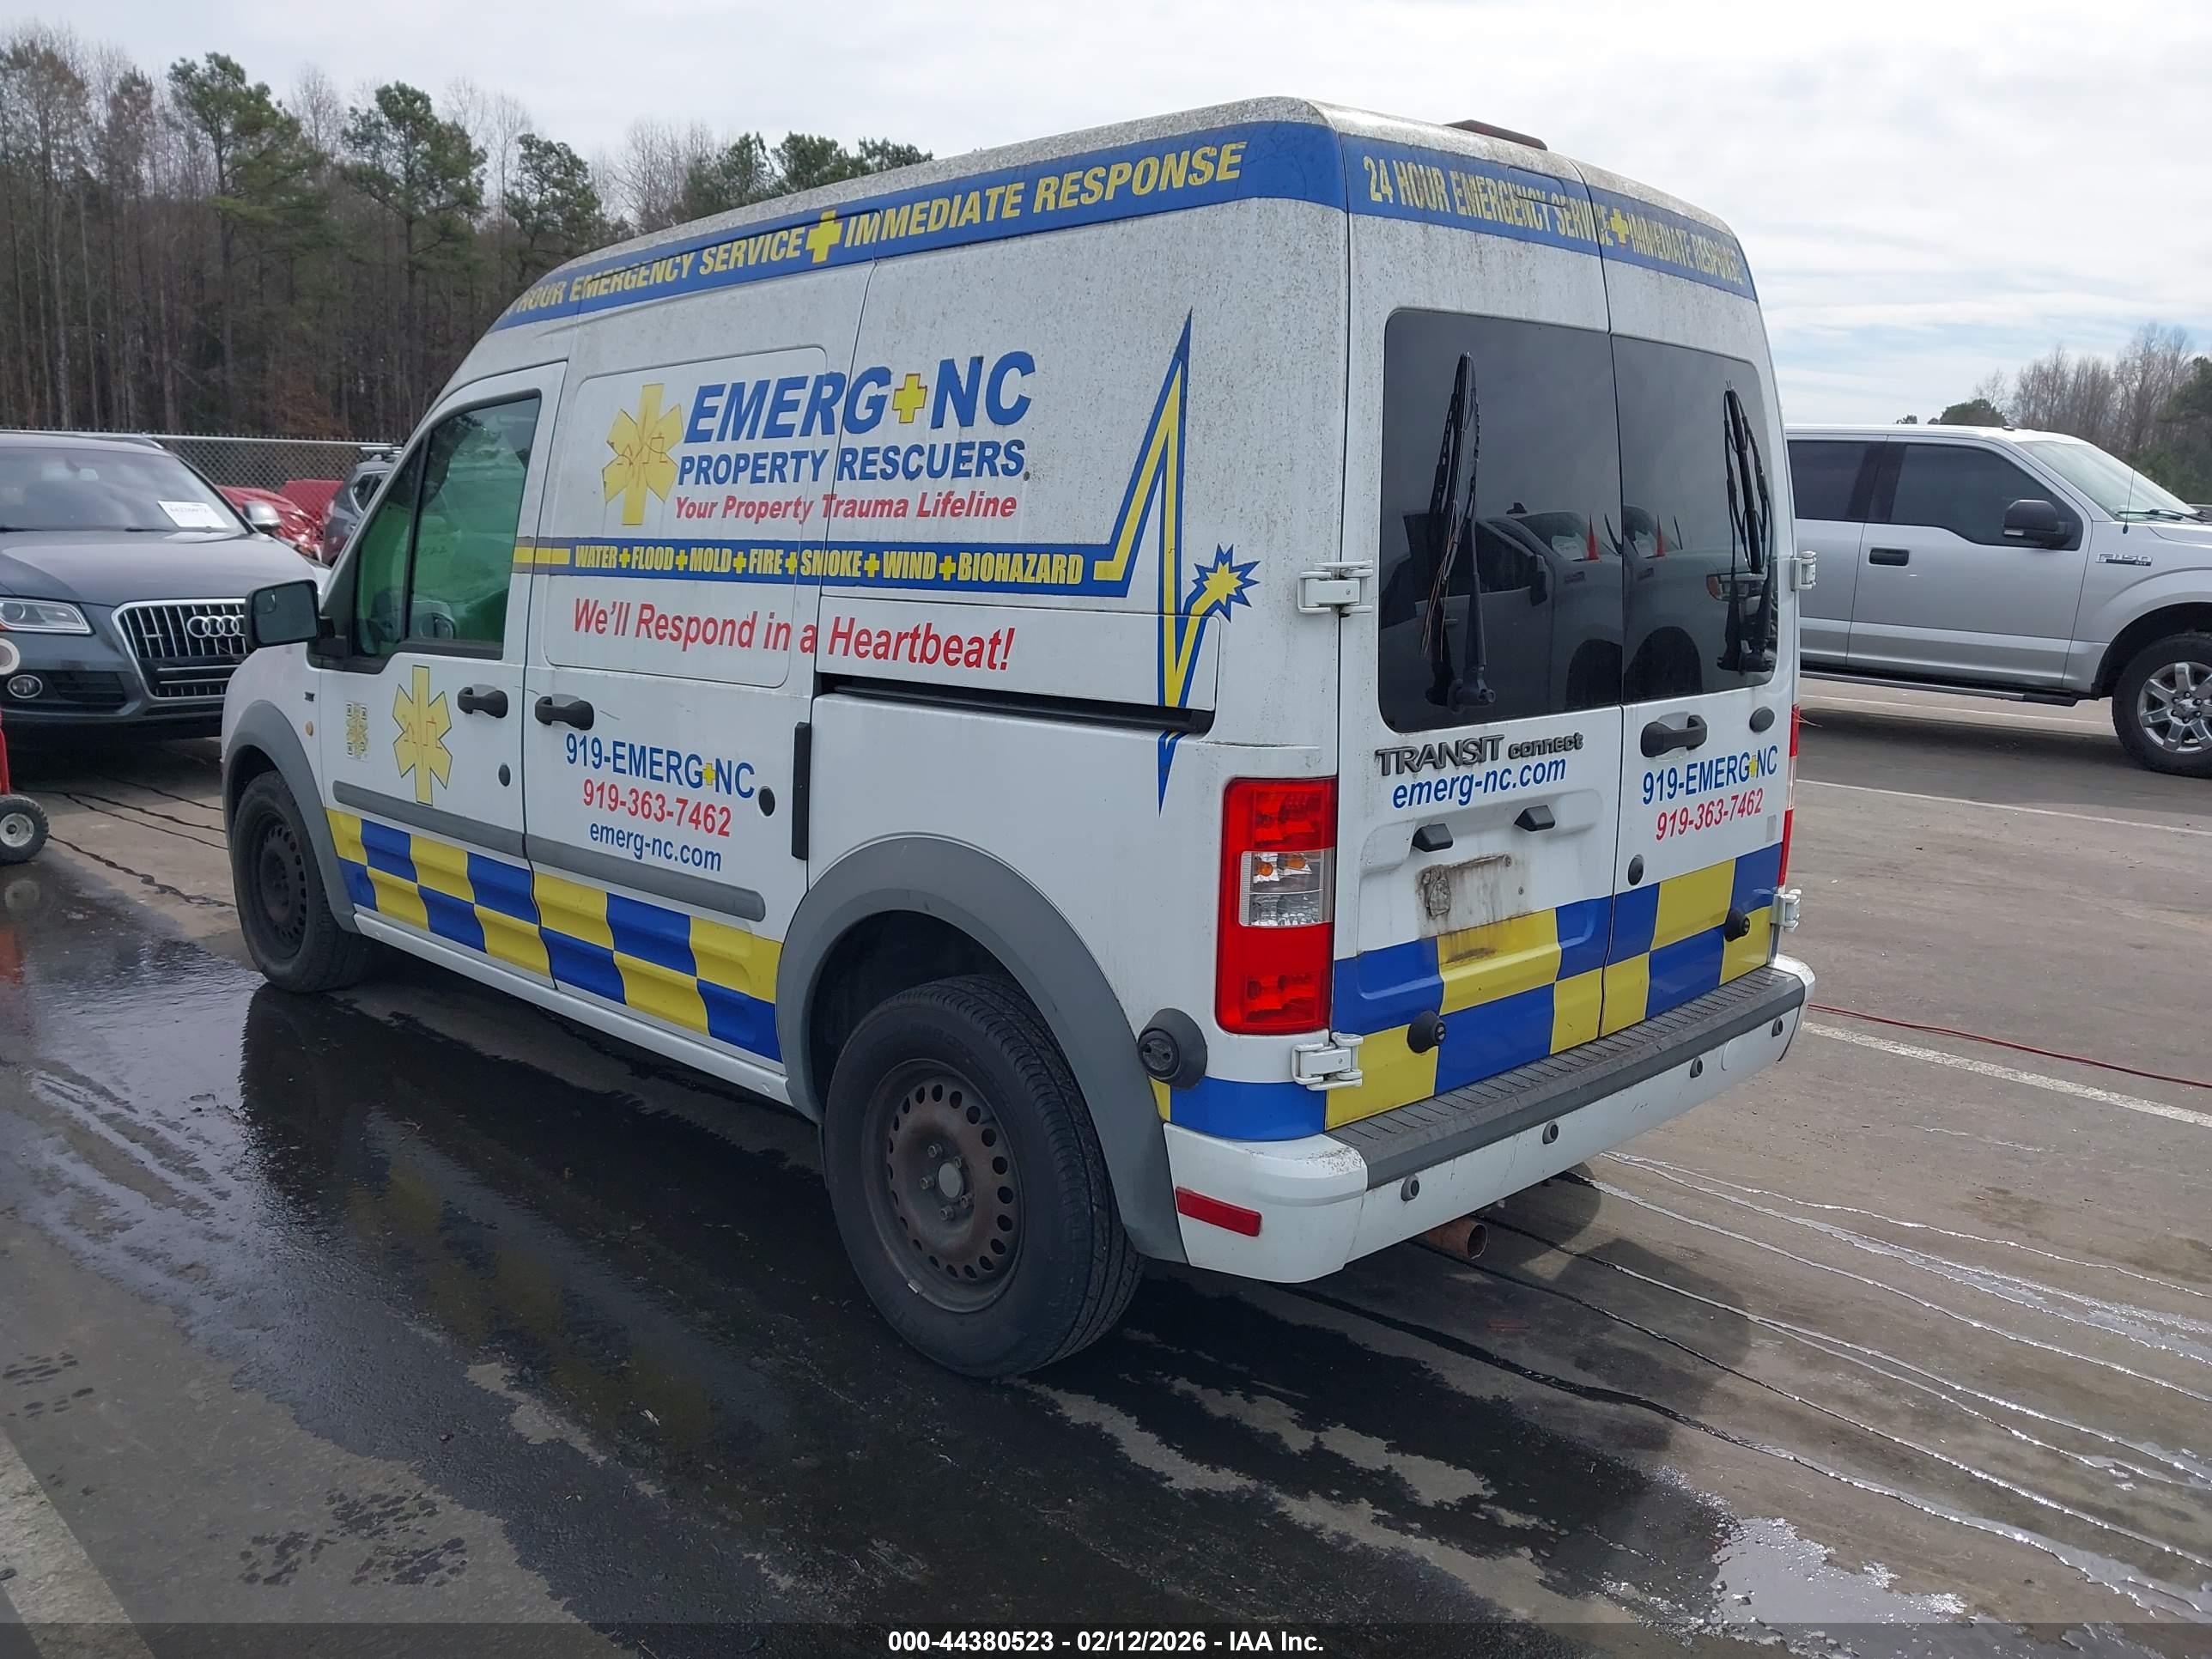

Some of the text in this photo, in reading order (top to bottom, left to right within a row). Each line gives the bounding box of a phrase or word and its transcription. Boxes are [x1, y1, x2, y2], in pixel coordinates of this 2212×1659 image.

[1364, 155, 1394, 204] 24
[1394, 159, 1451, 213] HOUR
[1451, 170, 1552, 232] EMERGENCY
[569, 252, 697, 302] EMERGENCY
[699, 228, 805, 276] SERVICE
[844, 182, 1025, 247] IMMEDIATE
[1033, 141, 1248, 214] RESPONSE
[678, 440, 1025, 486] PROPERTY RESCUERS
[675, 491, 1017, 525] Your Property Trauma Lifeline
[575, 544, 1084, 585] WATER FLOOD MOLD FIRE SMOKE WIND BIOHAZARD
[574, 598, 1017, 671] We'll Respond in a Heartbeat!
[1376, 732, 1584, 776] TRANSIT connect
[583, 778, 732, 838] 919-363-7462
[1393, 758, 1567, 809] emerg-nc.com
[1656, 787, 1765, 841] 919-363-7462
[589, 822, 722, 872] emerg-nc.com
